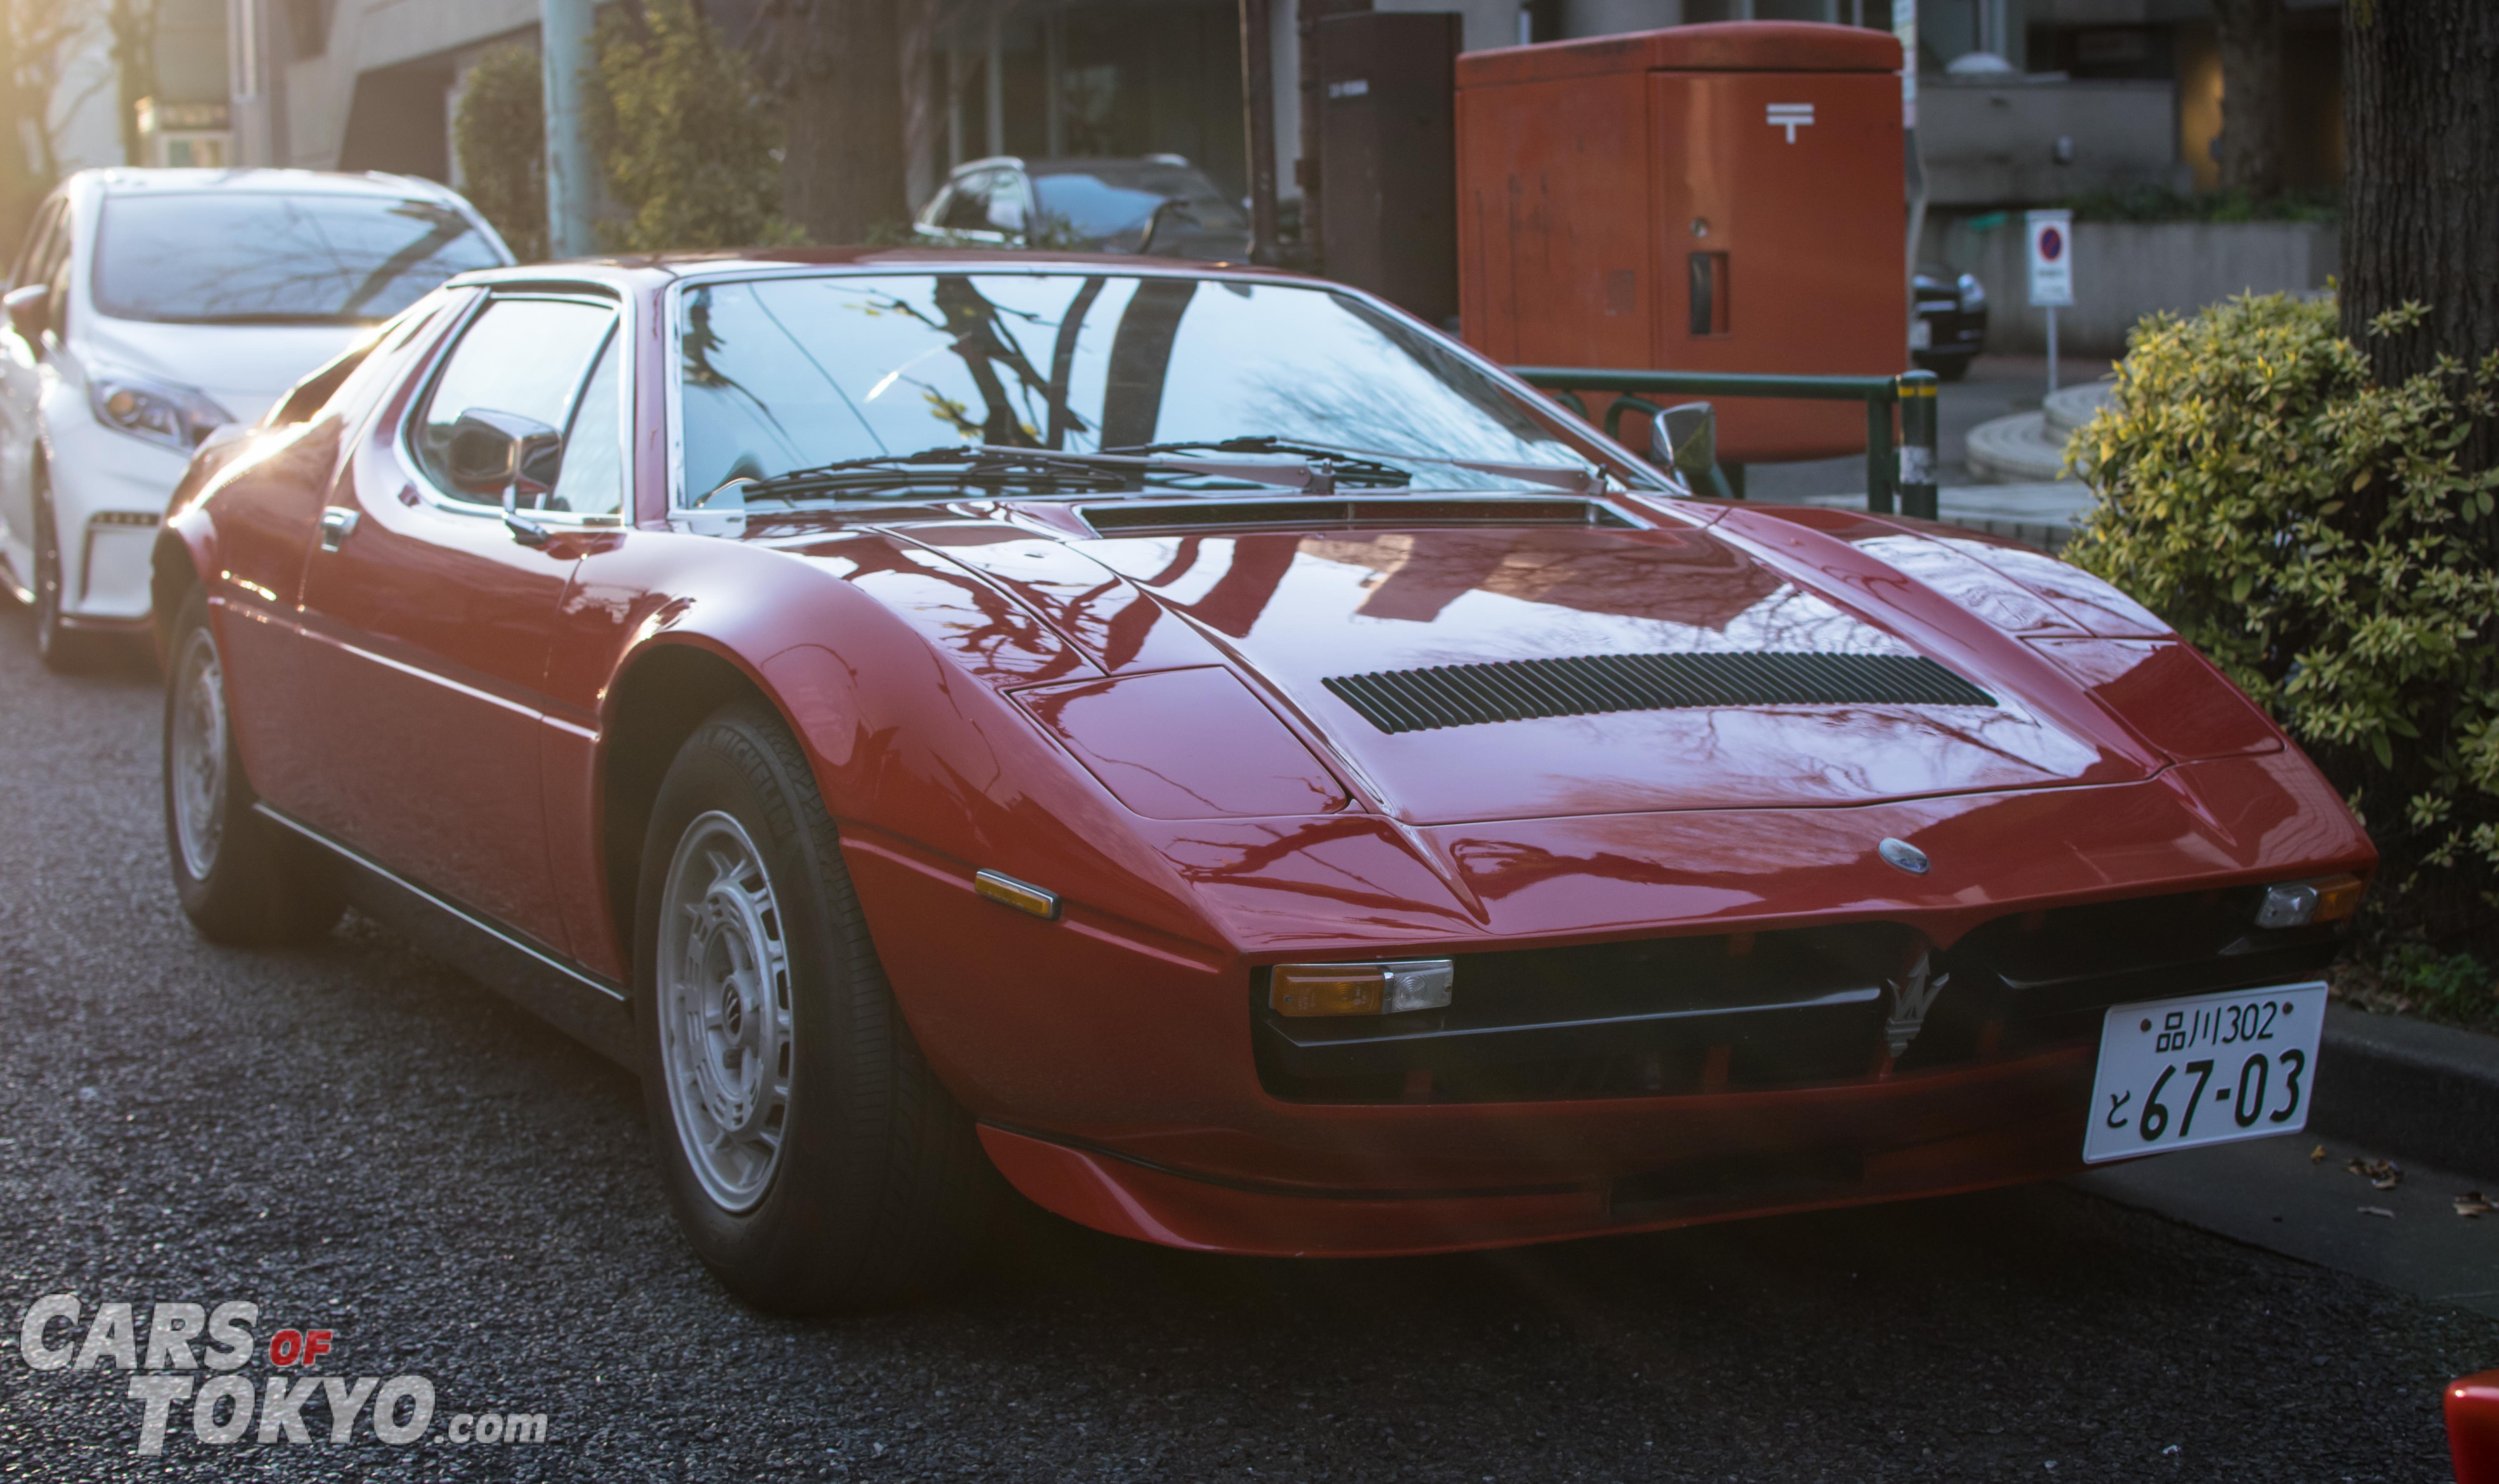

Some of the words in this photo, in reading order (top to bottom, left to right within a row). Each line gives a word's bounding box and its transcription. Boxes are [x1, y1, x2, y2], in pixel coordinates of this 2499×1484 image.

[710, 726, 796, 837] MICHELIN
[2107, 1090, 2130, 1128] と
[2140, 1048, 2305, 1141] 67-03
